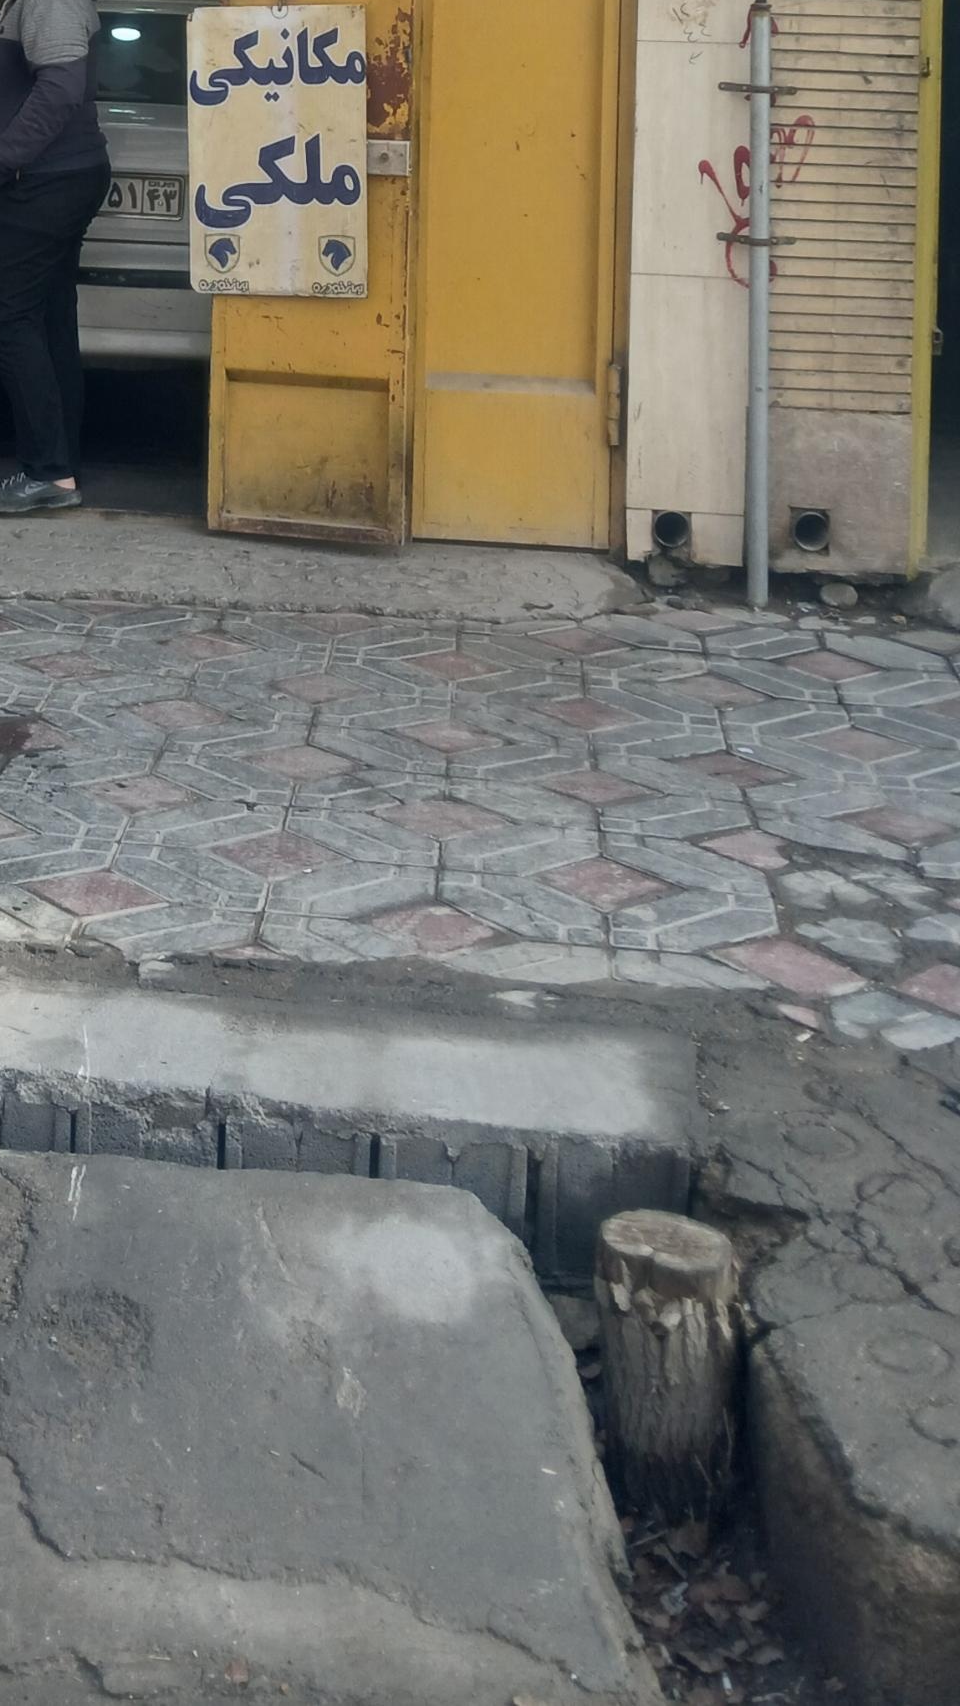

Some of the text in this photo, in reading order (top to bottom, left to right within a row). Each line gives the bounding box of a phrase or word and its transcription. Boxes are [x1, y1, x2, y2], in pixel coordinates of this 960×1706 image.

[189, 27, 366, 106] مکانیکی
[107, 181, 138, 209] ۵۱
[194, 133, 361, 229] ملکی
